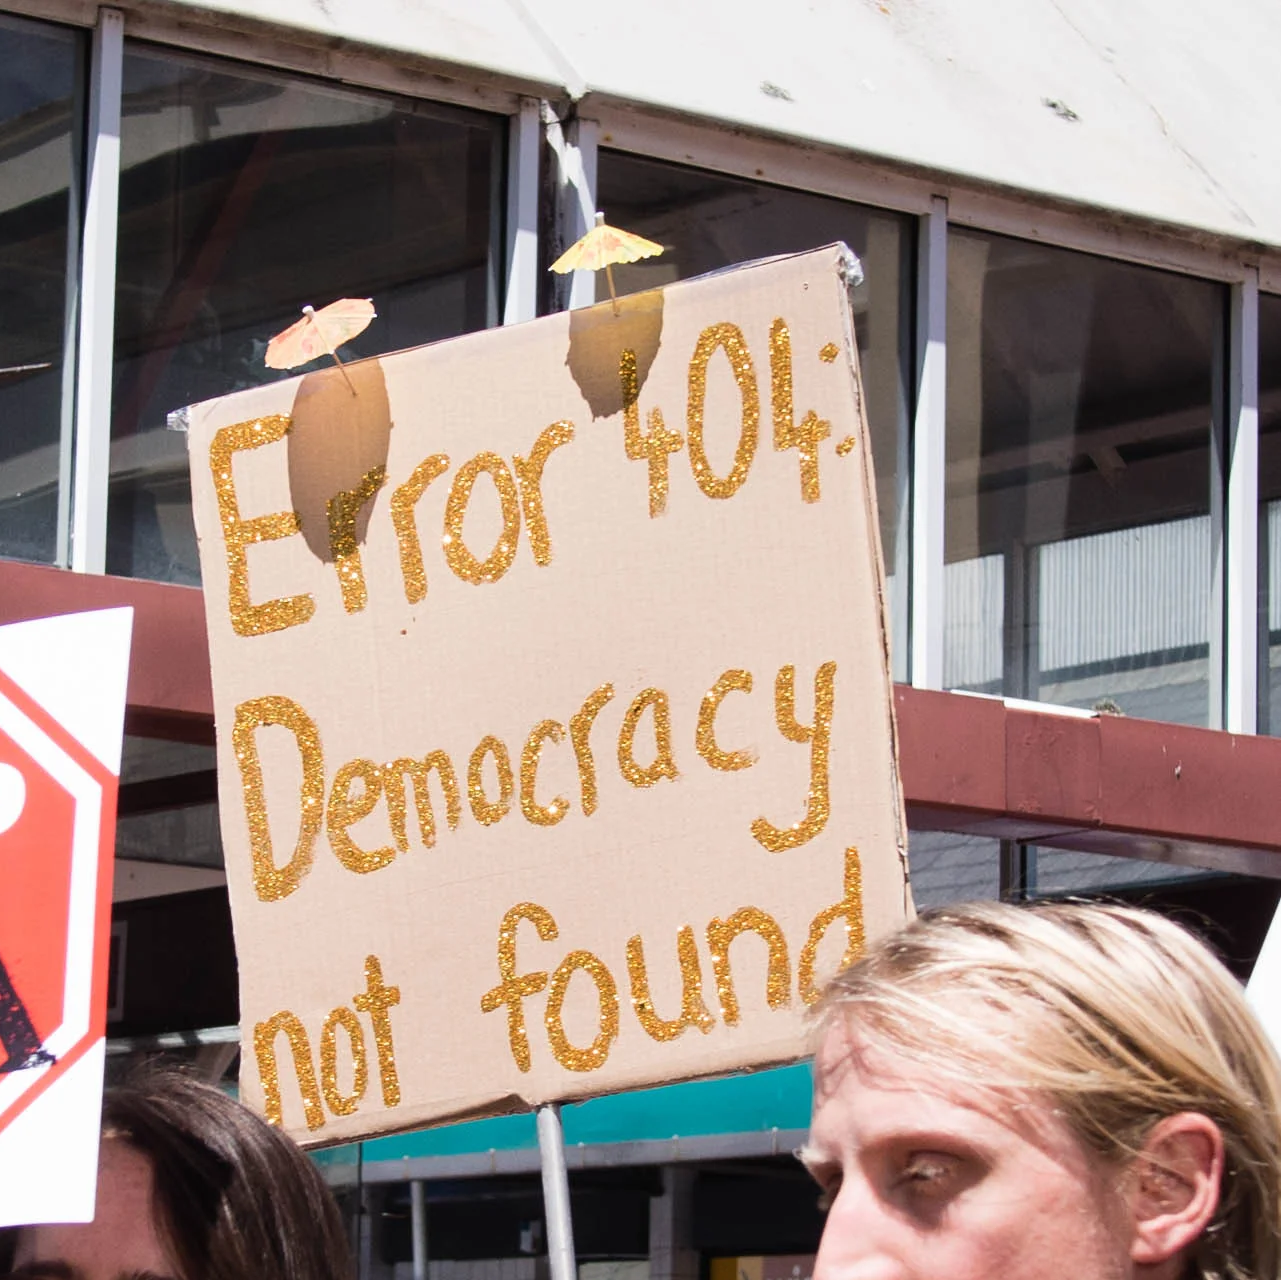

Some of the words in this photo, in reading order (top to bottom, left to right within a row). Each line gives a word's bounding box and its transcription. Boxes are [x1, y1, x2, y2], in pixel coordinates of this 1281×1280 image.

[208, 412, 577, 637] Error
[230, 659, 837, 903] Democracy
[252, 953, 401, 1132] not
[480, 845, 866, 1074] found
